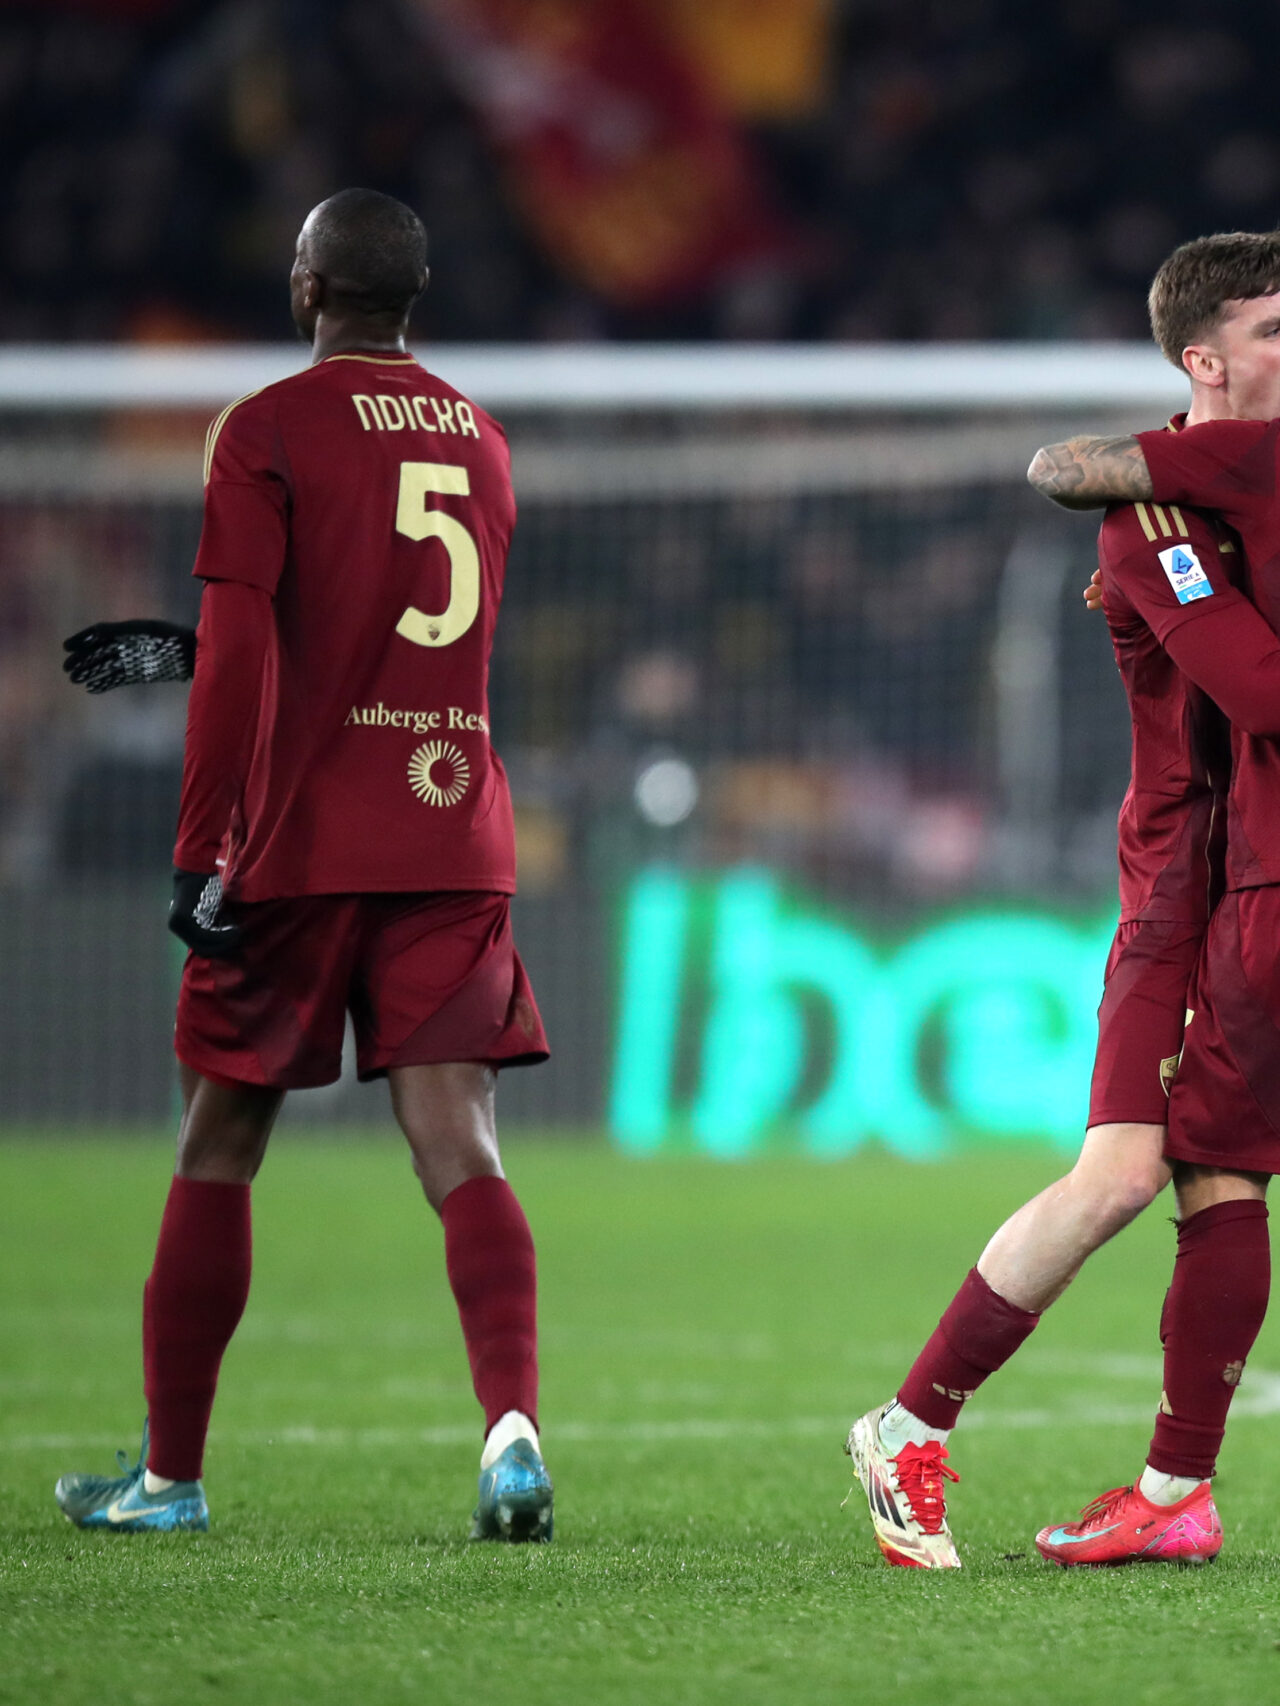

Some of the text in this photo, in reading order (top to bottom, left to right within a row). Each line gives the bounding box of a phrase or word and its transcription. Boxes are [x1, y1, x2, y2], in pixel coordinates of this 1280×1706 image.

[351, 393, 481, 439] NDICKA
[395, 461, 480, 648] 5
[1176, 574, 1194, 585] SERIE
[344, 701, 490, 738] Auberge Res
